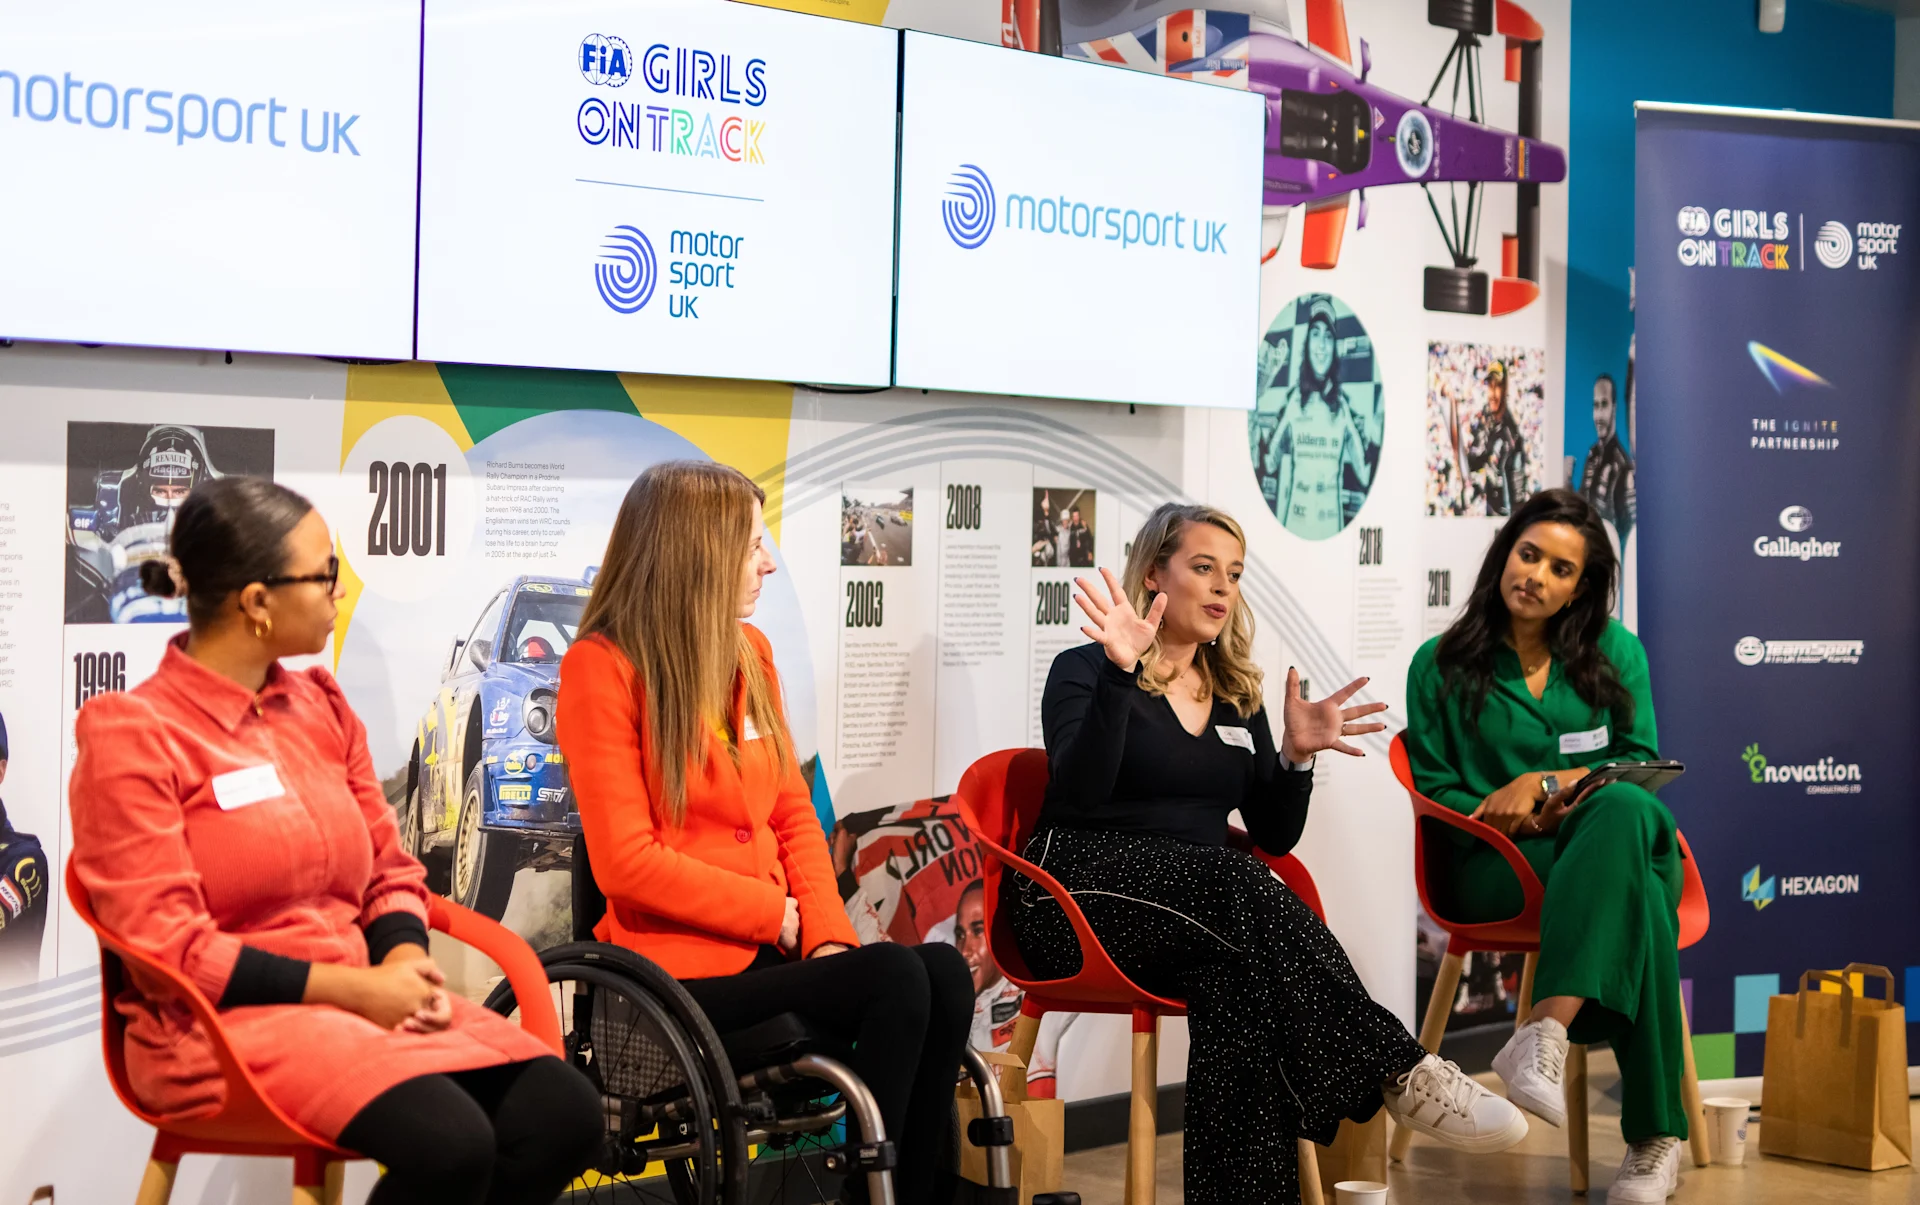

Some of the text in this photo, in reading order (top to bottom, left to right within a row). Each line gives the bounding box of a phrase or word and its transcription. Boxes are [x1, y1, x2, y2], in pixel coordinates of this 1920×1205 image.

[642, 43, 767, 107] GIRLS
[0, 69, 361, 157] motorsport UK
[1006, 193, 1228, 255] motorsport UK
[1713, 208, 1789, 241] GIRLS
[1857, 221, 1902, 239] motor
[670, 229, 745, 260] motor
[1858, 238, 1897, 255] sport
[669, 261, 736, 290] sport
[1858, 255, 1878, 271] UK
[669, 294, 699, 319] UK
[1752, 418, 1838, 433] THE IGNITE
[1751, 436, 1839, 451] PARTNERSHIP
[155, 454, 187, 465] RENAULT
[487, 461, 507, 469] Richard
[508, 461, 523, 469] Burns
[525, 462, 549, 470] becomes
[486, 472, 500, 481] Rally
[500, 472, 528, 481] Champion
[539, 473, 560, 481] Prodrive
[368, 460, 447, 557] 2001
[946, 484, 982, 530] 2008
[1358, 526, 1384, 565] 2018
[1753, 535, 1841, 562] Gallagher
[1036, 581, 1070, 625] 2009
[1427, 570, 1452, 607] 2019
[845, 581, 884, 628] 2003
[73, 651, 126, 711] 1996
[499, 785, 532, 801] PIRELLI
[1781, 874, 1860, 896] HEXAGON
